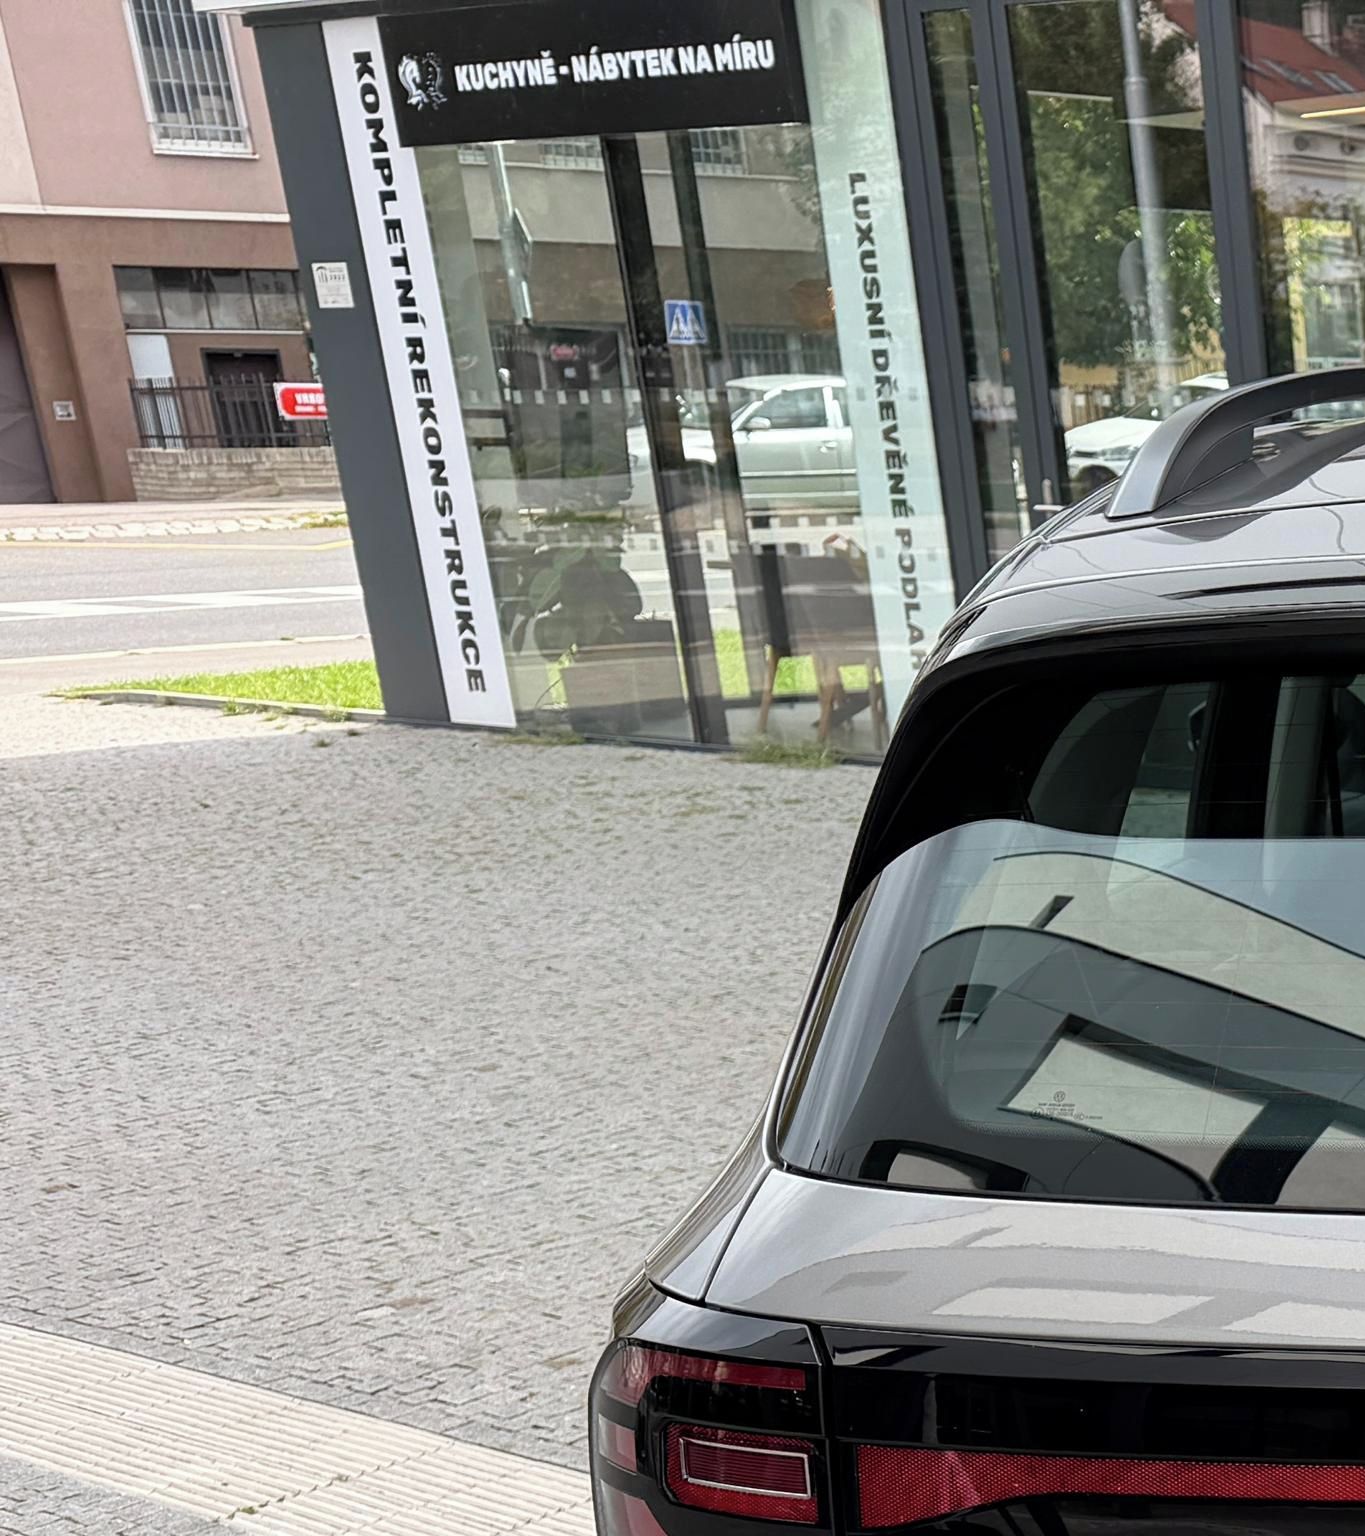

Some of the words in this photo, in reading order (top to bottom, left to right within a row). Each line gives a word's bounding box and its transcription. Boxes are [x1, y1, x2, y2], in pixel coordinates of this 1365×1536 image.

[454, 50, 557, 92] KUCHYNĚ
[571, 46, 677, 84] NÁBYTEK
[678, 44, 713, 74] NA
[713, 33, 775, 71] MÍRU
[352, 50, 427, 329] KOMPLETNÍ
[405, 336, 486, 693] REKONSTRUKCE
[848, 172, 894, 343] LUXUSNÍ
[871, 348, 916, 519] DŘEVĚNÉ
[894, 527, 928, 671] PODLAH
